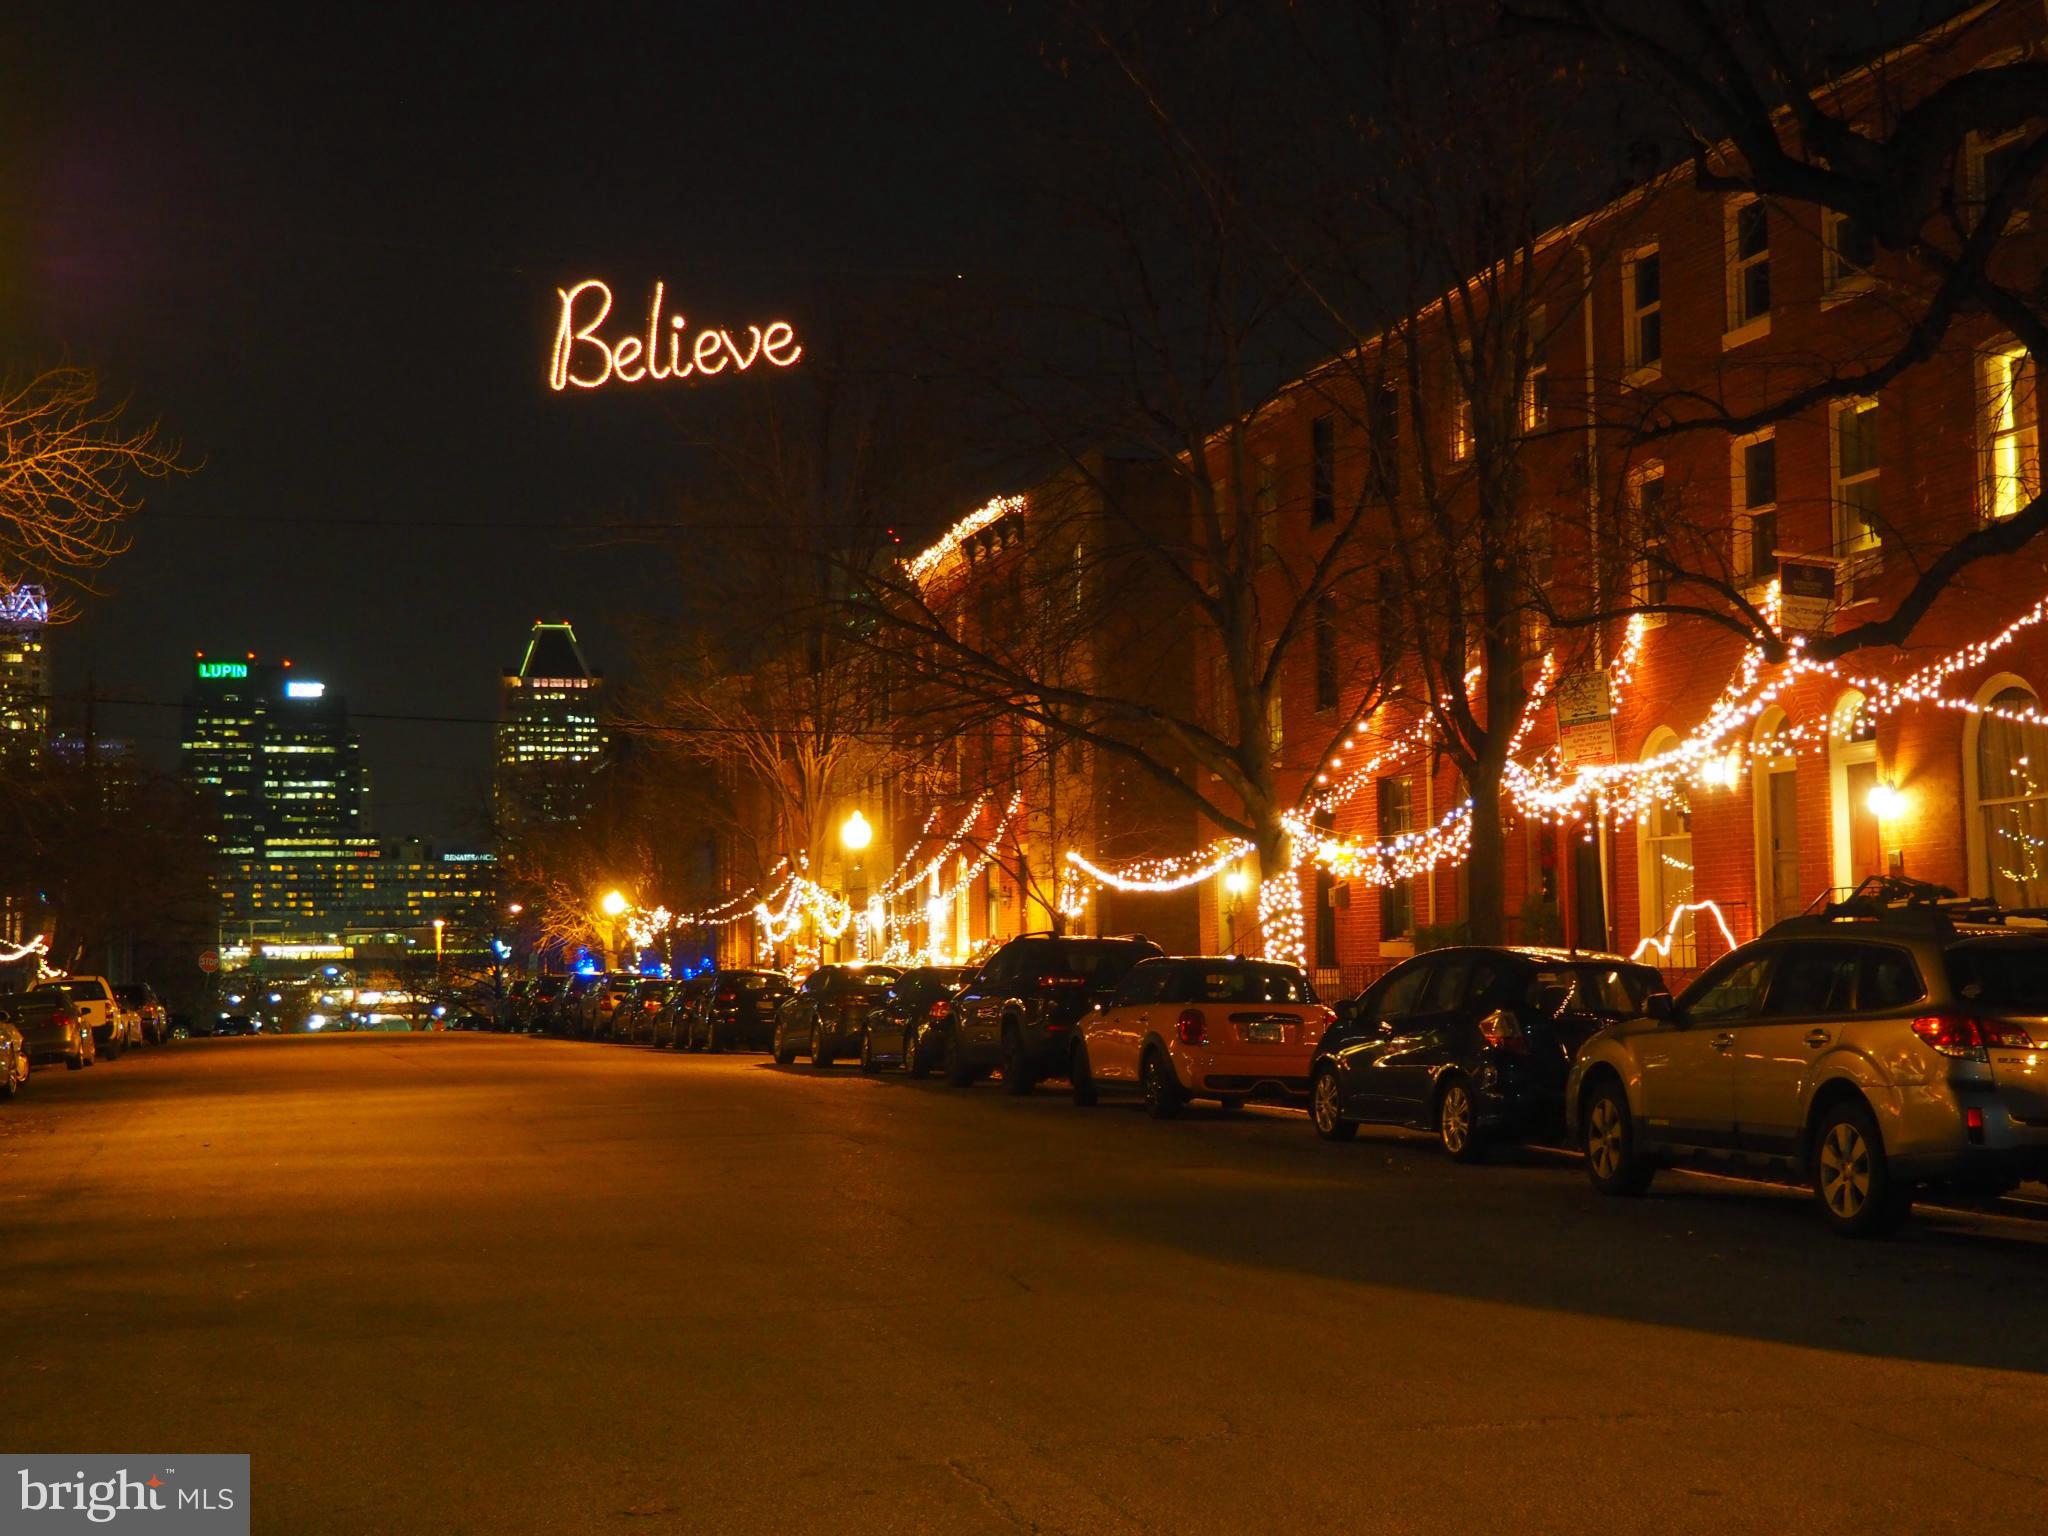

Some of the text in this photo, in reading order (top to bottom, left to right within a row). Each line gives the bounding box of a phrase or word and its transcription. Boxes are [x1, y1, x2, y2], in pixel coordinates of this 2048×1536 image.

[550, 279, 802, 391] Believe
[200, 664, 248, 678] LUPIN
[444, 853, 496, 861] RENAISSANCE
[200, 957, 219, 966] STOP
